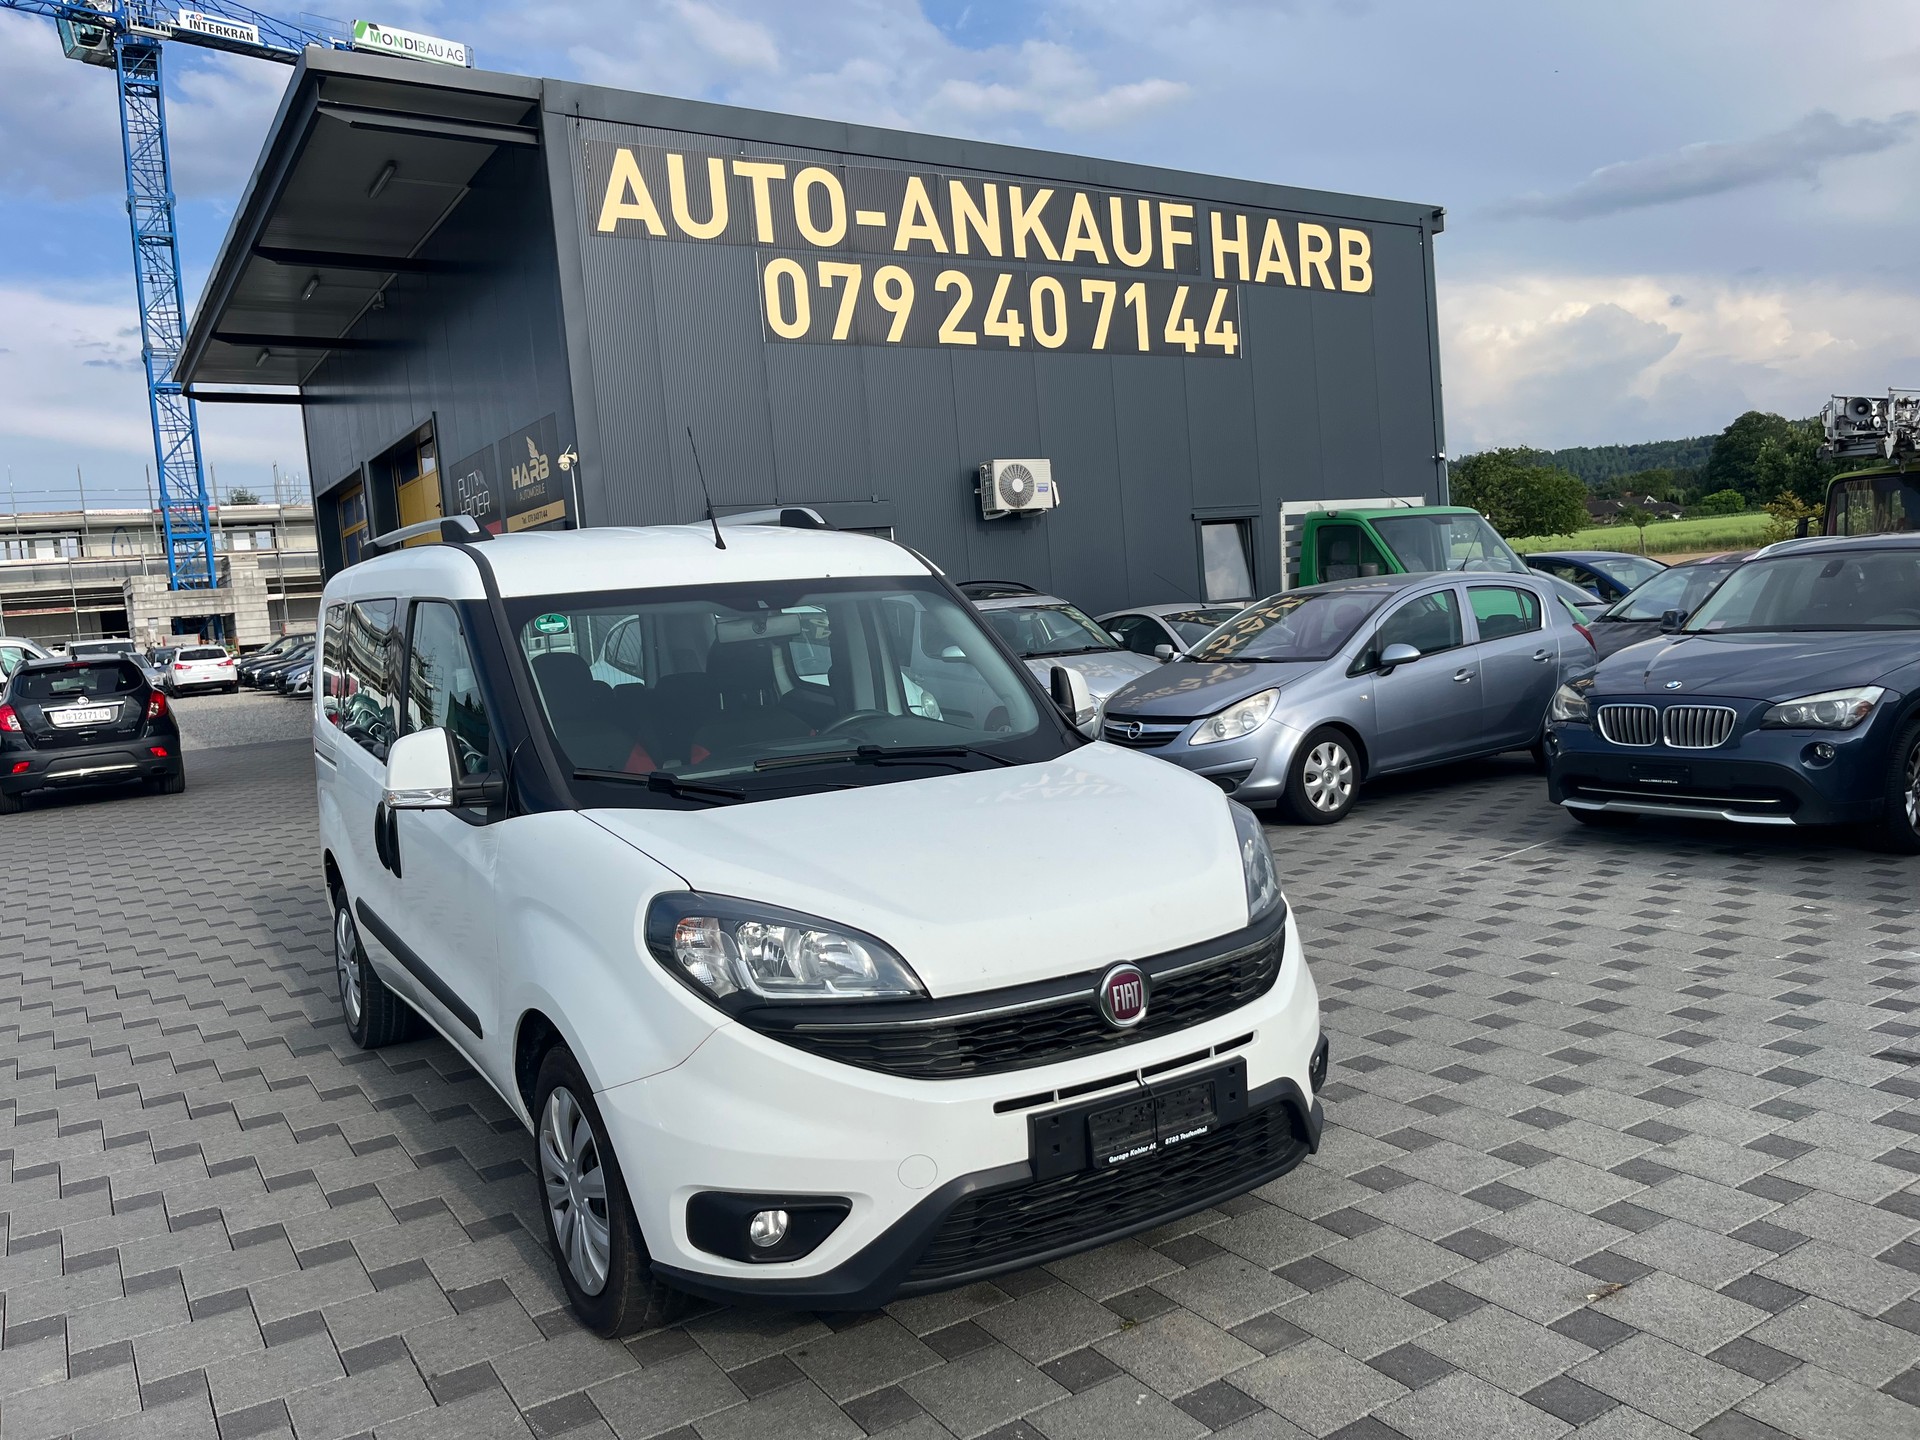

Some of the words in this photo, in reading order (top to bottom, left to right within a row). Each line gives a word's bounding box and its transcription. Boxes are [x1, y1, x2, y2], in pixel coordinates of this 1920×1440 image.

[189, 19, 254, 42] INTERKRAN
[370, 30, 444, 58] MONDIBAU
[446, 47, 464, 62] AG
[597, 148, 1194, 271] AUTO-ANKAUF
[1209, 211, 1374, 294] HARB
[511, 454, 550, 490] HARB
[1112, 981, 1139, 1011] FIAT
[1108, 1152, 1129, 1163] Garage
